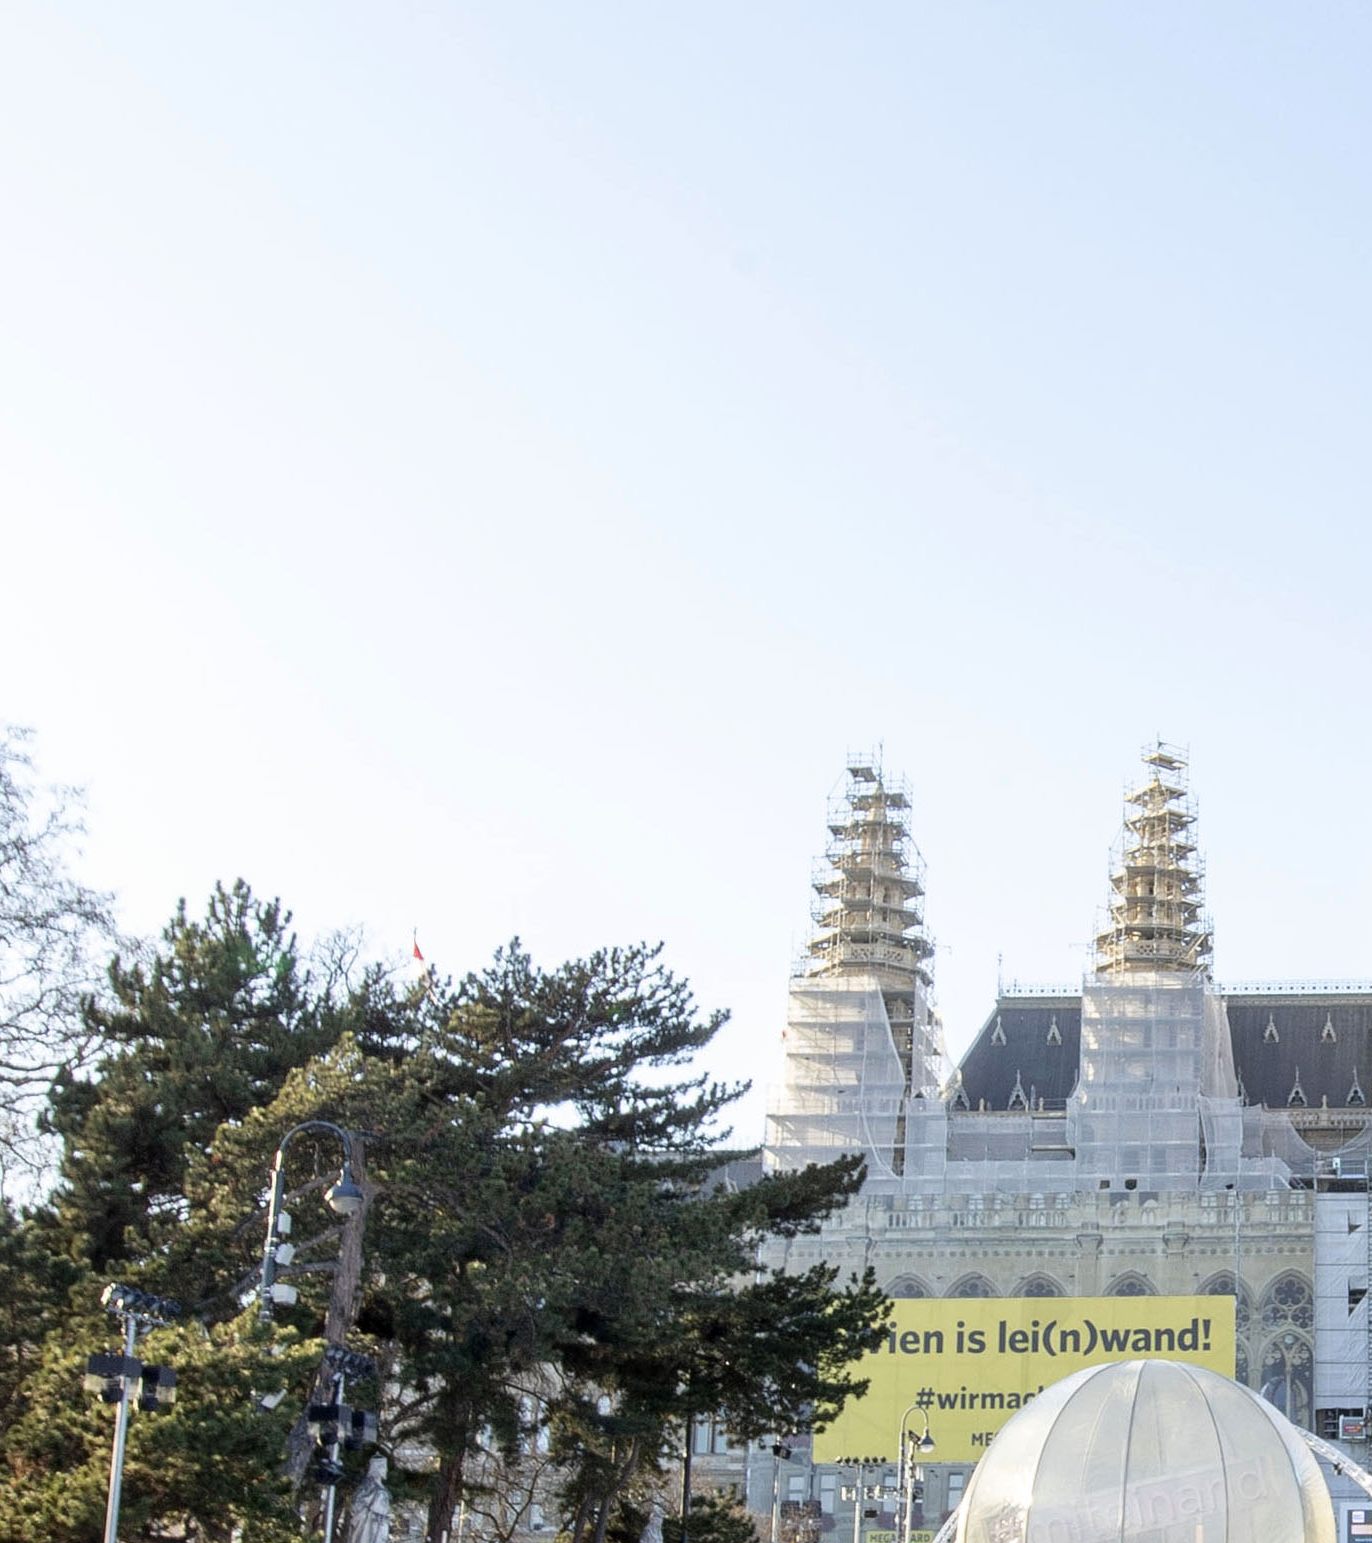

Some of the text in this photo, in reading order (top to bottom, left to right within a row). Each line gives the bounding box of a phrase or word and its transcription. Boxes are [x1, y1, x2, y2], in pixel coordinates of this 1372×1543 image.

[869, 1318, 1211, 1357] ien is lei(n)wand!
[915, 1385, 1044, 1410] #wirmac
[971, 1431, 999, 1447] ME
[870, 1533, 930, 1543] MEGAARD
